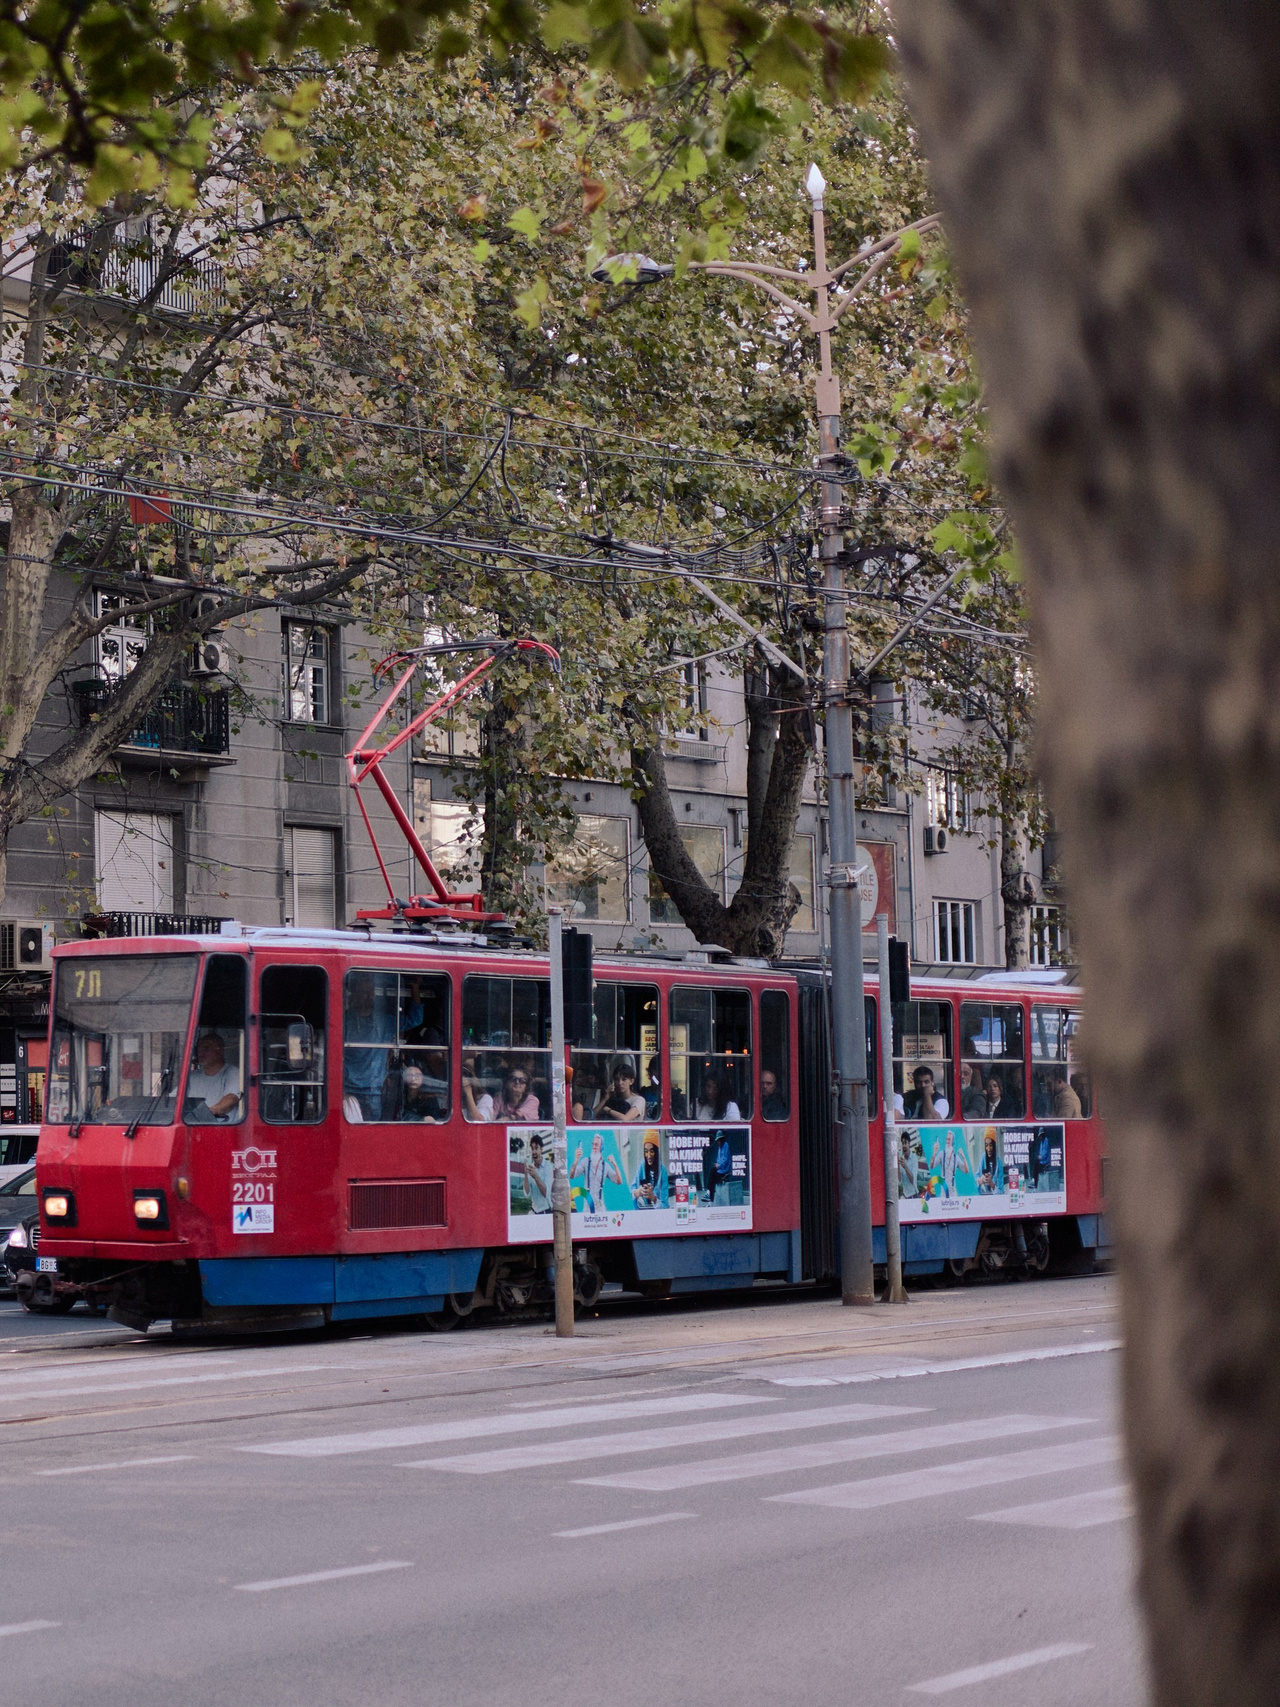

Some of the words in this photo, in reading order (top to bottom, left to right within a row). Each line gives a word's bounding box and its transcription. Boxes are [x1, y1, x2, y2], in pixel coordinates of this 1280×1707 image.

[669, 1136, 692, 1148] НОВЕ
[231, 1146, 277, 1173] ГСП
[669, 1150, 681, 1160] НА
[682, 1149, 703, 1160] КЛИК
[669, 1162, 682, 1175] ОД
[233, 1183, 274, 1202] 2201
[584, 1215, 608, 1223] lutrija.rs
[41, 1260, 49, 1270] BG
